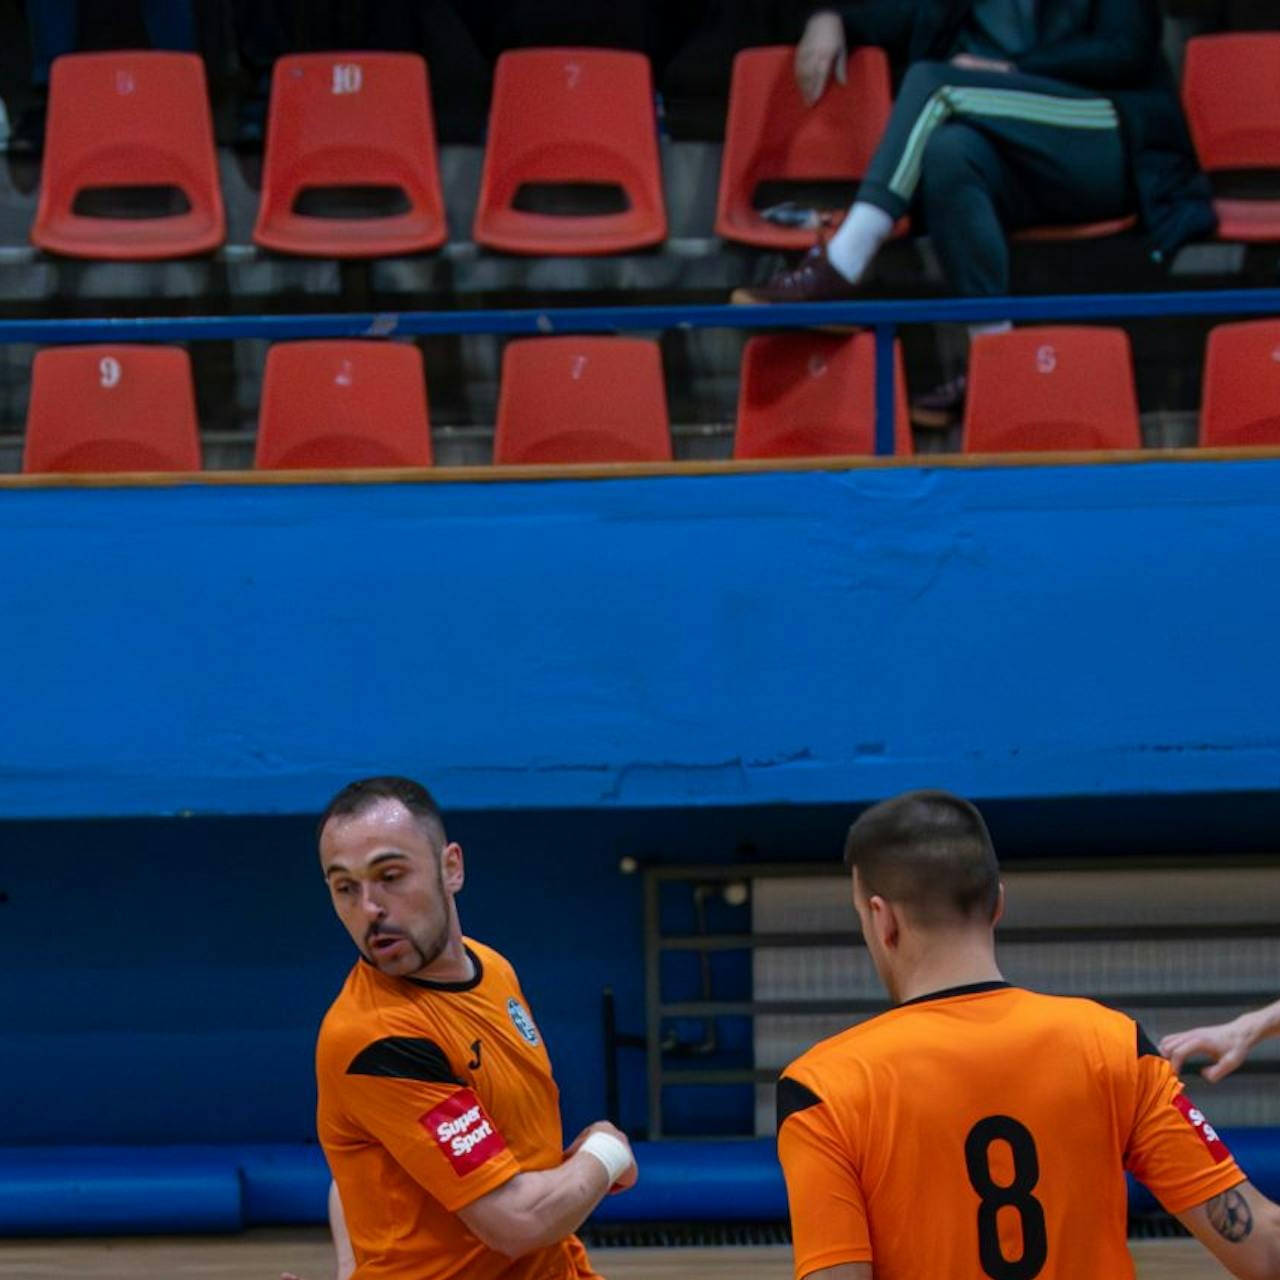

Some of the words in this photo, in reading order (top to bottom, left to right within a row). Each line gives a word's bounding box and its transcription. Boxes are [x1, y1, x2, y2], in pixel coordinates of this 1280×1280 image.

[332, 63, 363, 95] 10
[99, 356, 122, 388] 9
[436, 1104, 481, 1143] Super
[451, 1119, 493, 1157] Sport
